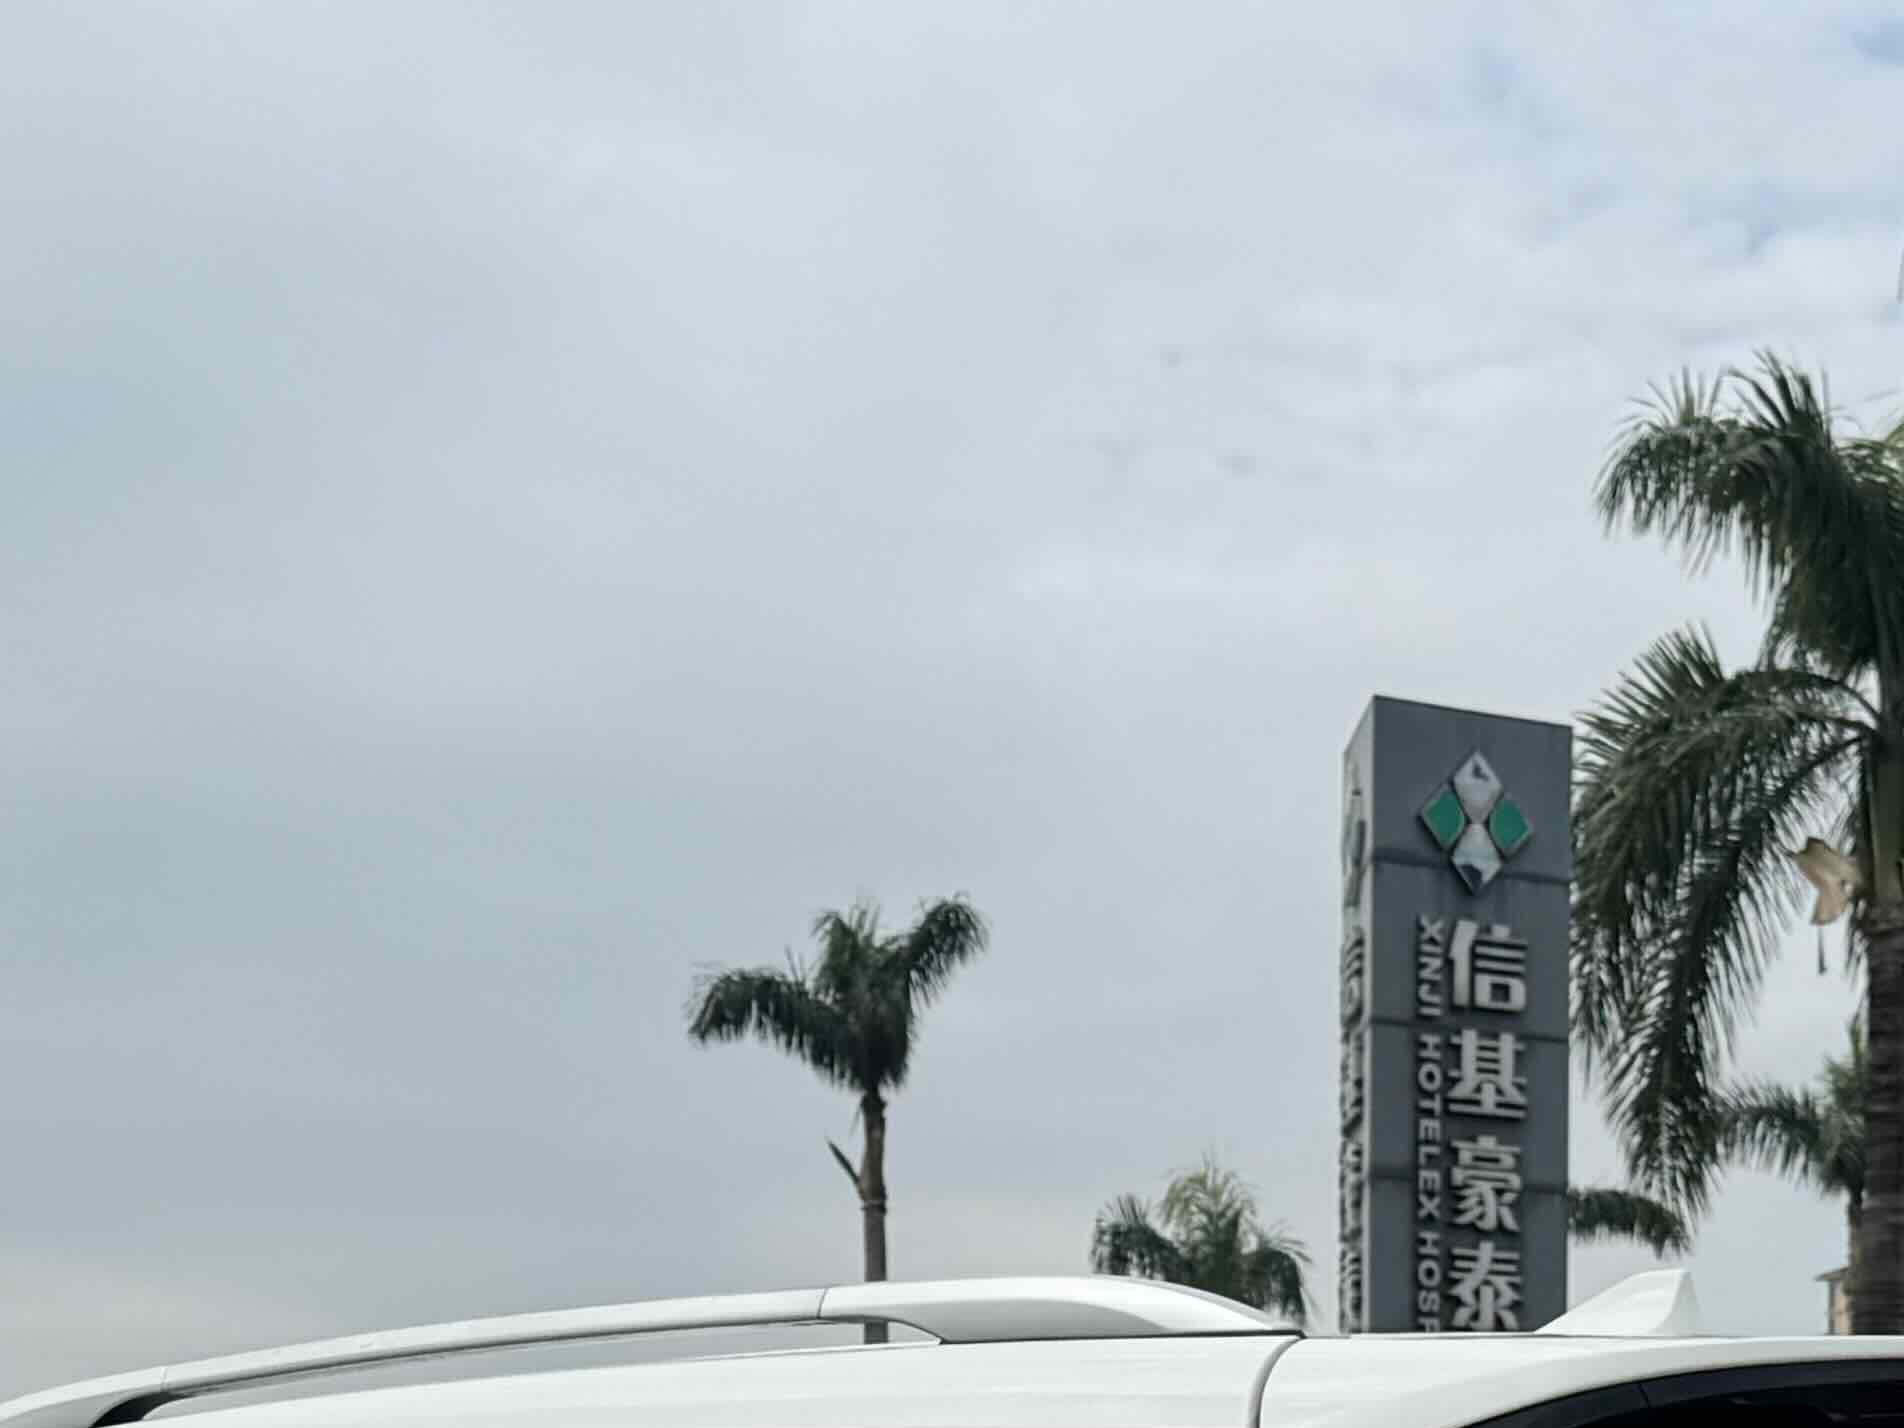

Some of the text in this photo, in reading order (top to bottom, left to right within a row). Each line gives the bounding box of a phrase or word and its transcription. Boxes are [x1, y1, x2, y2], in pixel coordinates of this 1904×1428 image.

[1416, 913, 1446, 1018] XINJI
[1416, 1034, 1444, 1218] HOTELEX
[1448, 916, 1529, 1331] 信基豪泰
